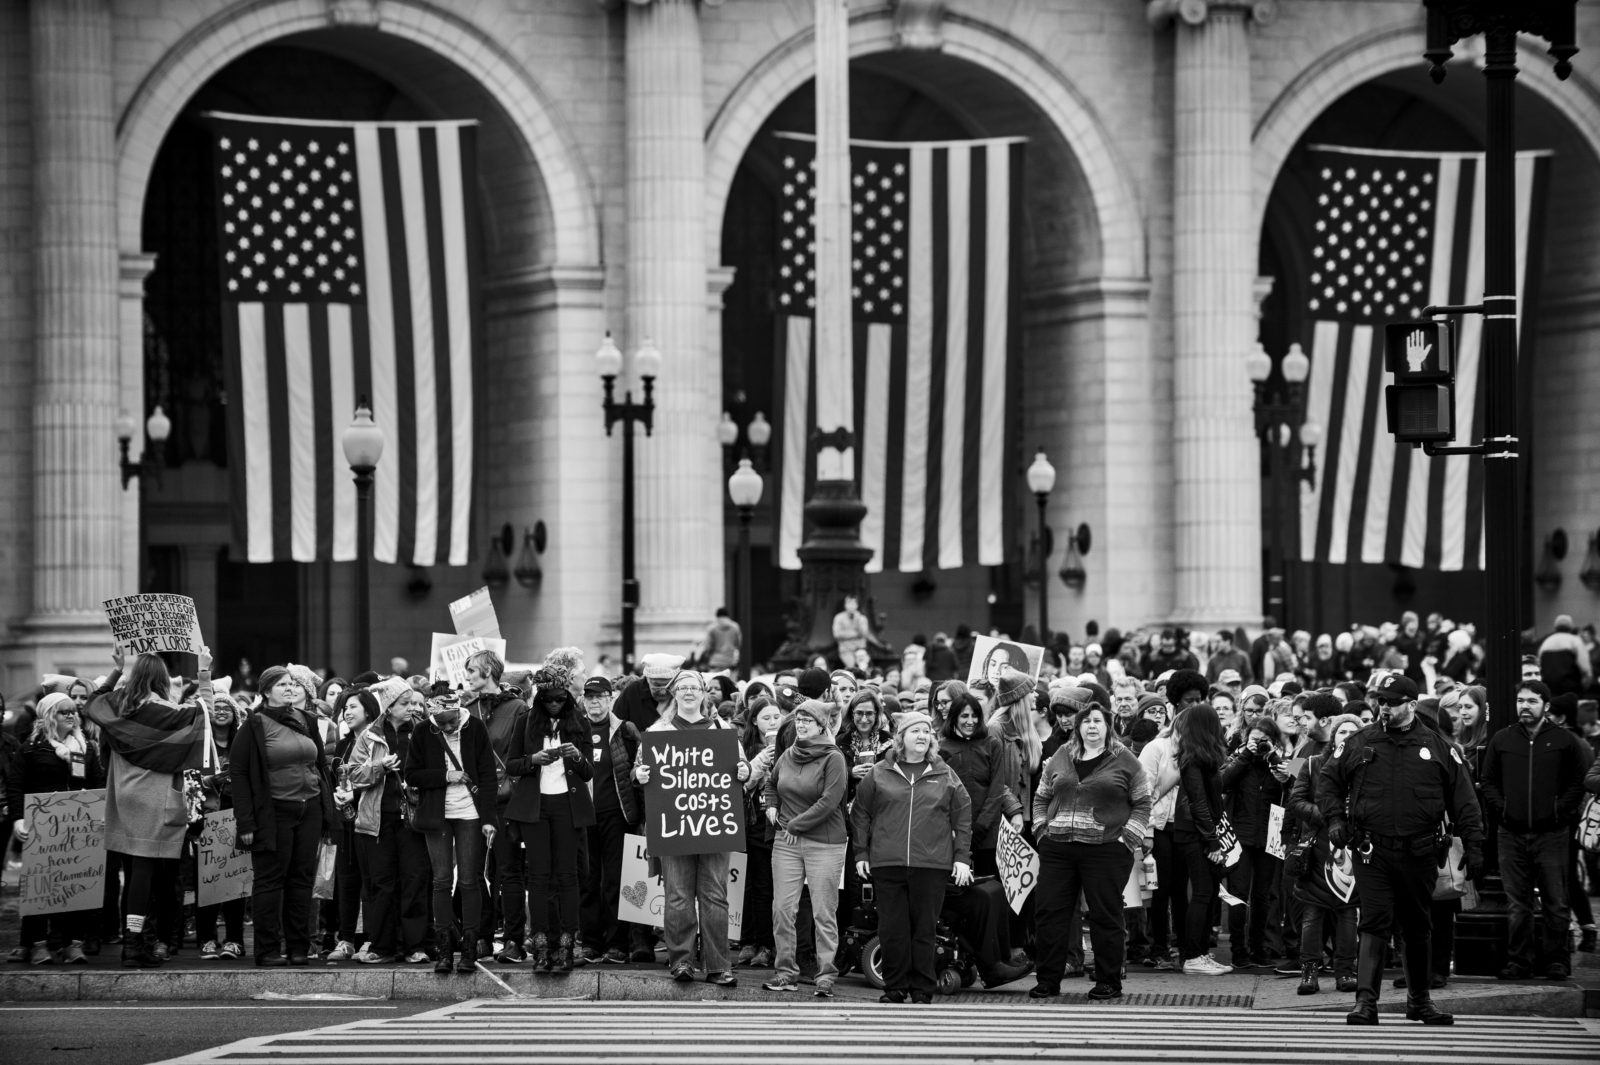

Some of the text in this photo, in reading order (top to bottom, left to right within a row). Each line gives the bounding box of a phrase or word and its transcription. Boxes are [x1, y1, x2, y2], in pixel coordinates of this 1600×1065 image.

[105, 605, 130, 617] THAT
[130, 602, 155, 613] DIVIDE
[169, 602, 176, 612] IT
[176, 603, 184, 612] IS
[183, 604, 196, 616] OUR
[114, 598, 123, 606] IS
[124, 594, 141, 604] NOT
[142, 594, 158, 602] OUR
[108, 612, 146, 627] INABILITY
[148, 611, 160, 620] TO
[143, 619, 157, 628] AND
[114, 629, 142, 642] THOSE
[162, 635, 194, 653] LORDE
[651, 743, 714, 767] White
[659, 764, 732, 790] Silence
[40, 807, 91, 837] girls
[36, 834, 101, 855] want to
[1000, 820, 1034, 868] AMERICA
[47, 855, 90, 868] have
[200, 849, 228, 869] They
[42, 882, 96, 909] rights
